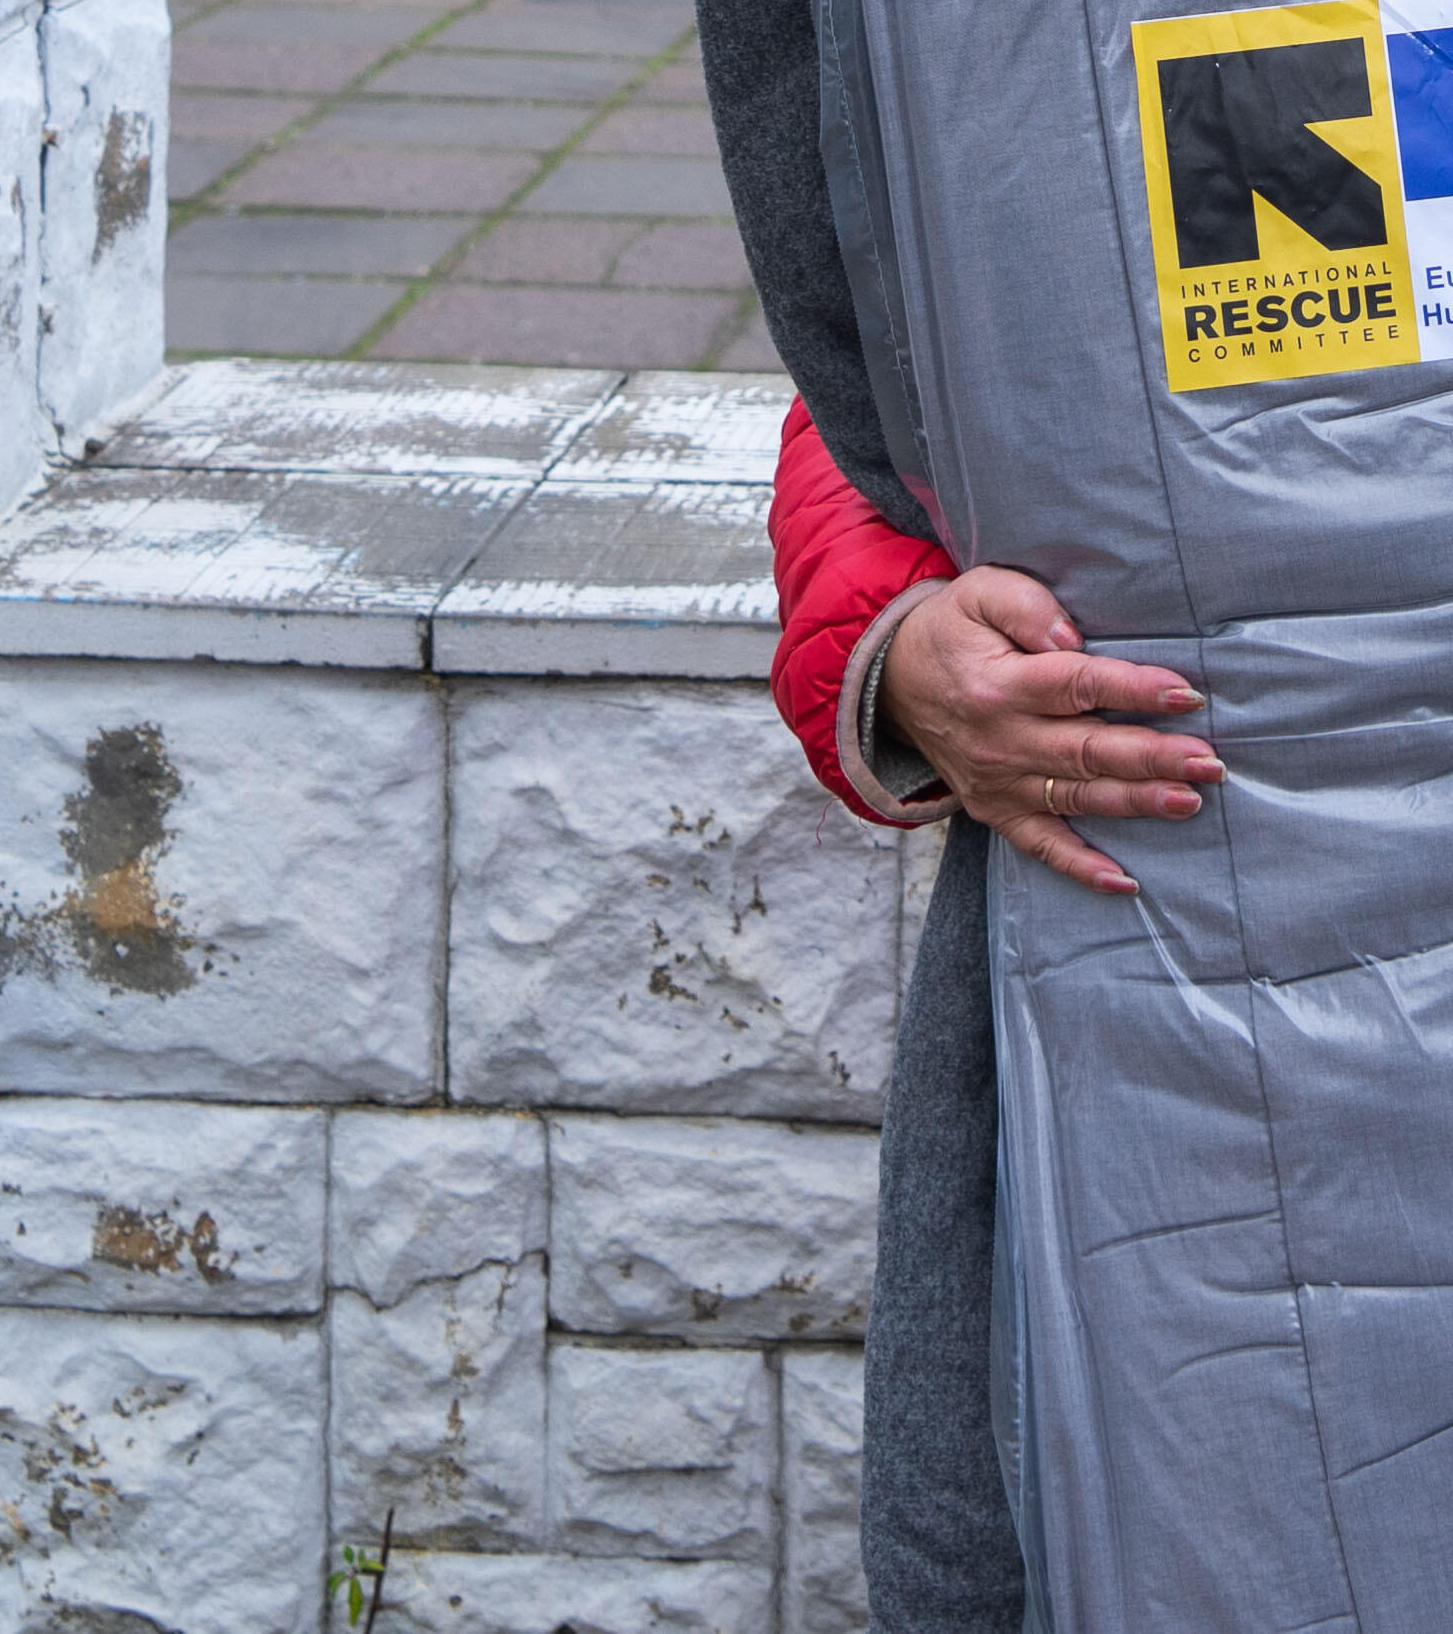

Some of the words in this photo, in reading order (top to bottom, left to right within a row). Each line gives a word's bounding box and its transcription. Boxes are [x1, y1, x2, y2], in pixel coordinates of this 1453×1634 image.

[1181, 261, 1392, 299] INTERNATIONAL
[1184, 282, 1397, 342] RESCUE
[1188, 324, 1400, 363] COMMITTEE
